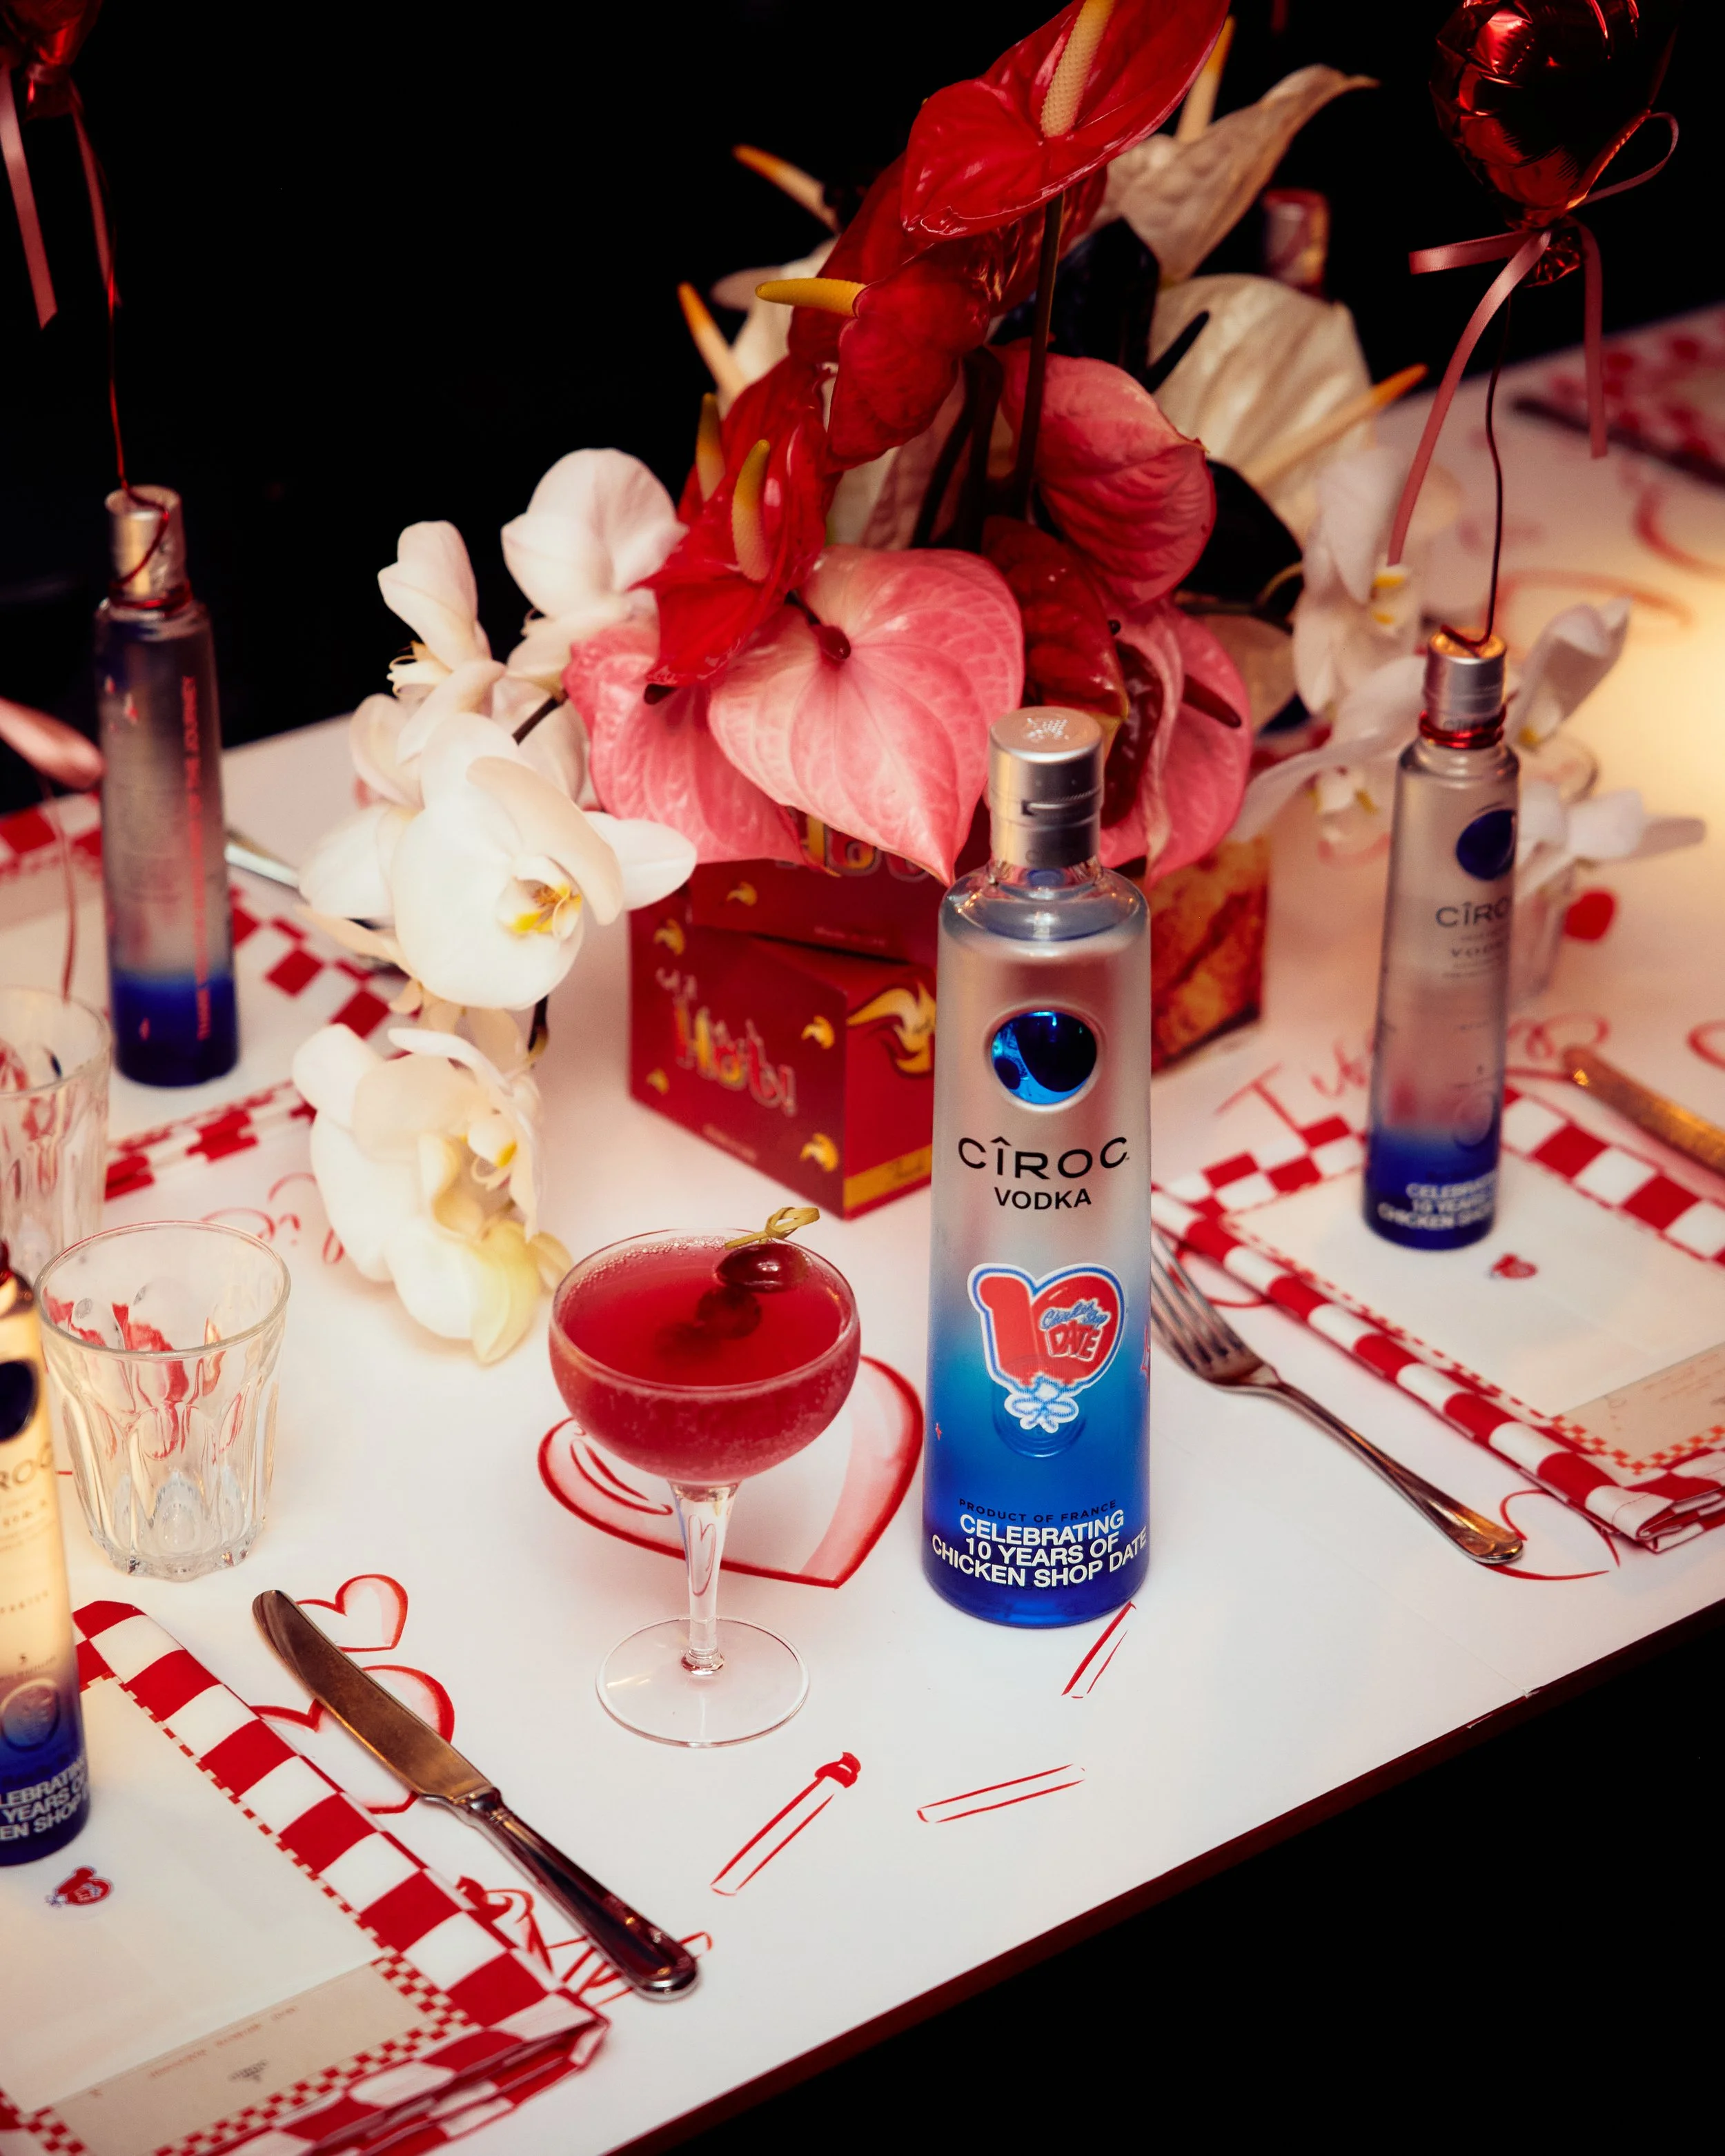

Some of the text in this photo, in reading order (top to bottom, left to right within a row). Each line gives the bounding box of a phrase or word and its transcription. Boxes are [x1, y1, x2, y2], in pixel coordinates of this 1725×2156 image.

[958, 1136, 1128, 1180] CÎROC
[994, 1187, 1092, 1210] VODKA
[1046, 1320, 1102, 1361] DATE
[959, 1498, 1116, 1523] PRODUCT OF FRANCE
[960, 1509, 1125, 1546] CELEBRATING
[931, 1525, 1147, 1588] CHICKEN SHOP DATE
[966, 1530, 1120, 1567] 10 YEARS OF
[1, 1787, 70, 1823] YEARS
